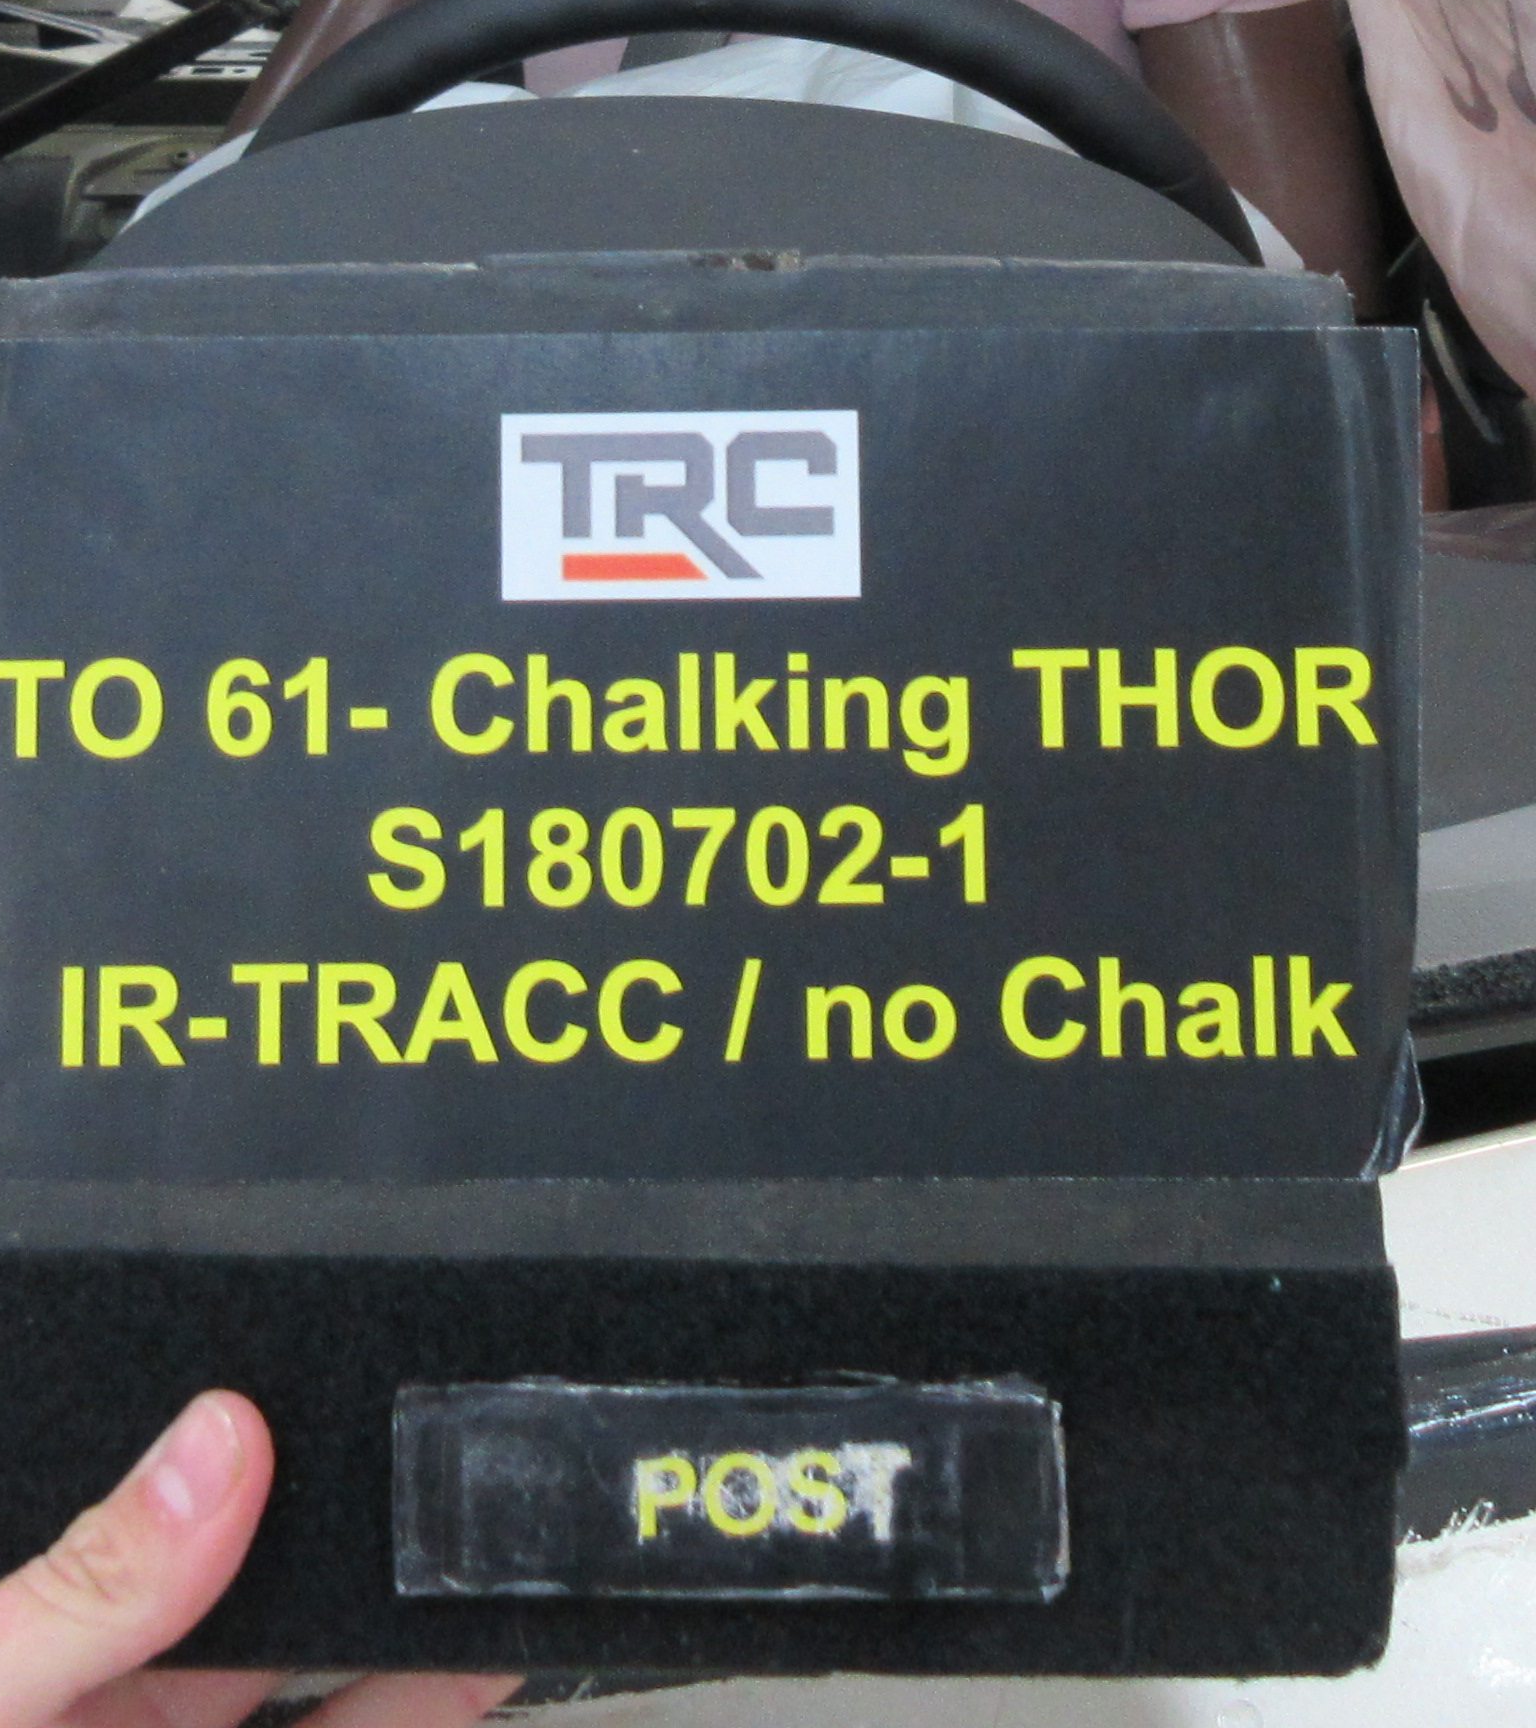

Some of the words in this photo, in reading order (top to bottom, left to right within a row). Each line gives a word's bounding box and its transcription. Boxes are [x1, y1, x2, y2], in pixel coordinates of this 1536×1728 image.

[521, 431, 837, 579] TRC
[204, 656, 390, 759] 61-
[428, 650, 971, 778] Chalking
[1010, 644, 1380, 750] THOR
[366, 802, 988, 911] S180702-1
[58, 958, 685, 1069] IR-TRACC
[723, 956, 764, 1063] /
[804, 983, 959, 1062] no
[1000, 954, 1359, 1061] Chalk
[633, 1442, 913, 1544] POST
